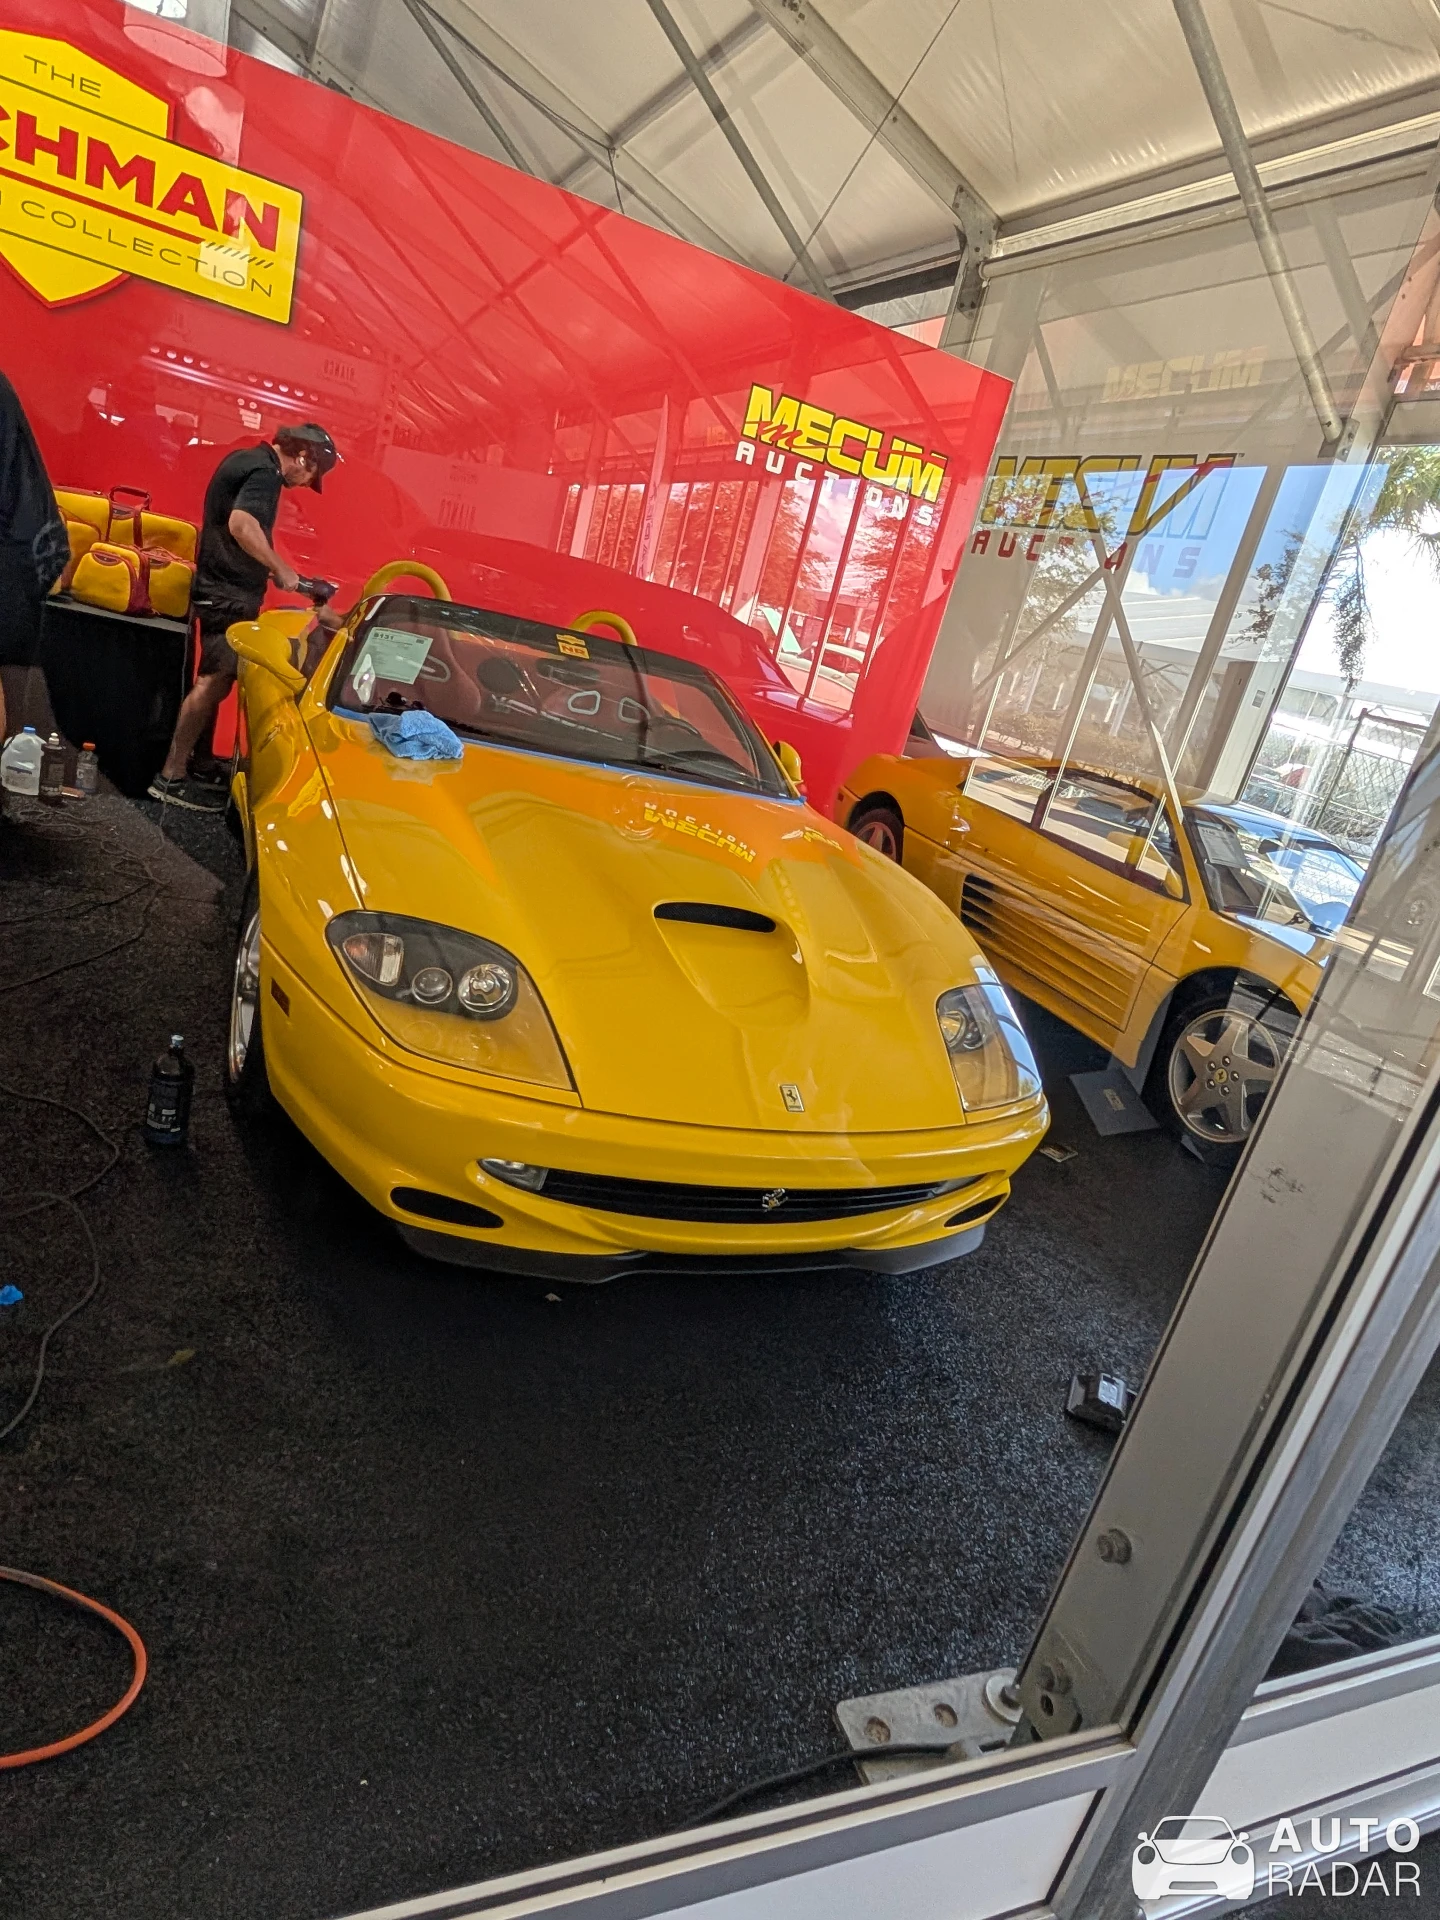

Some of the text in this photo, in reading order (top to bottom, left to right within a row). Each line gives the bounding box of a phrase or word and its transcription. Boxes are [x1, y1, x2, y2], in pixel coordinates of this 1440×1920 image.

[23, 54, 102, 99] THE
[0, 105, 280, 252] HMAN
[20, 200, 273, 298] COLLECTION
[735, 440, 934, 527] AUCTIONS
[741, 382, 949, 503] MECUM
[981, 453, 1237, 541] MECUM
[970, 529, 1201, 578] AUCTONS
